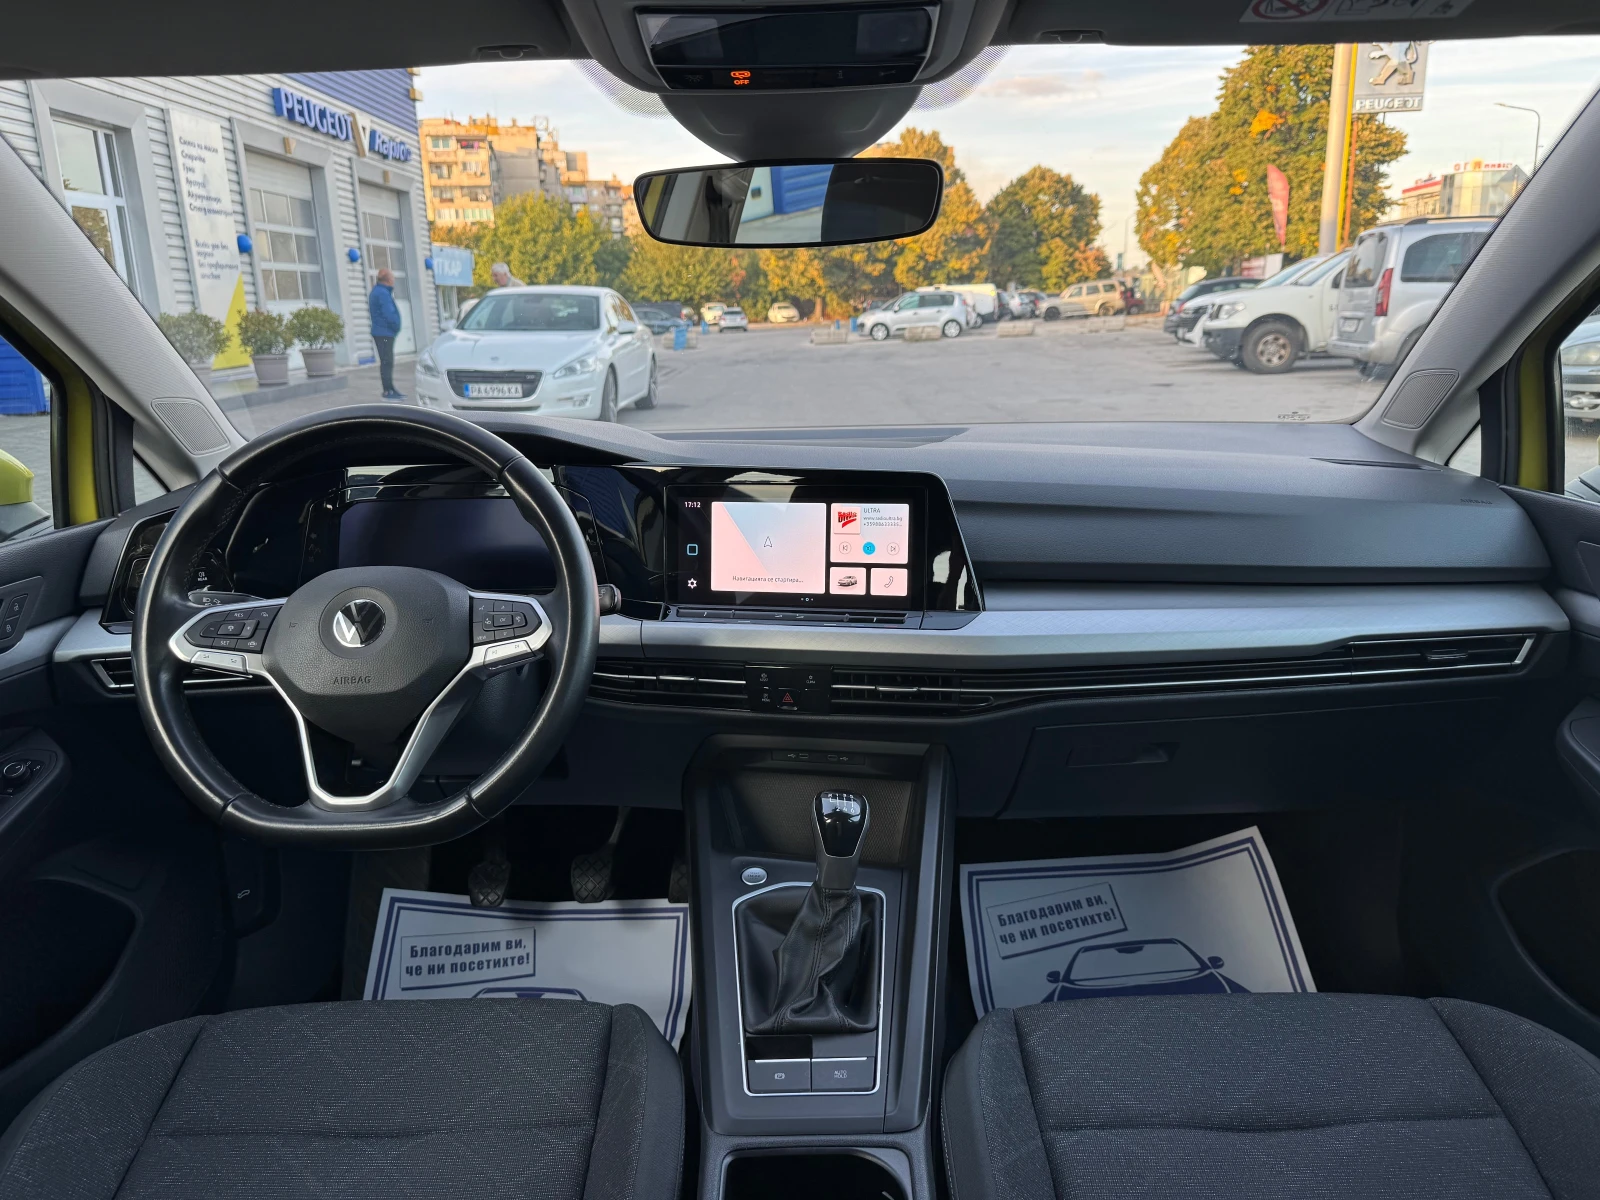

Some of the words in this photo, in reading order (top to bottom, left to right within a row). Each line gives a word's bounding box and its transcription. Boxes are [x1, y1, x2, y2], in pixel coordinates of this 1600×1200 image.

[279, 87, 354, 142] PEUGEOT
[1355, 96, 1423, 111] PEUGEOT
[333, 675, 372, 685] AIRBAG
[997, 899, 1083, 927] Благодарим
[999, 931, 1017, 945] че
[1019, 927, 1038, 941] ни
[1040, 907, 1117, 936] посетихте!
[410, 940, 501, 958] Благодарим
[505, 938, 527, 950] ви,
[405, 965, 423, 976] че
[427, 963, 446, 975] ни
[450, 952, 530, 974] посетихте!
